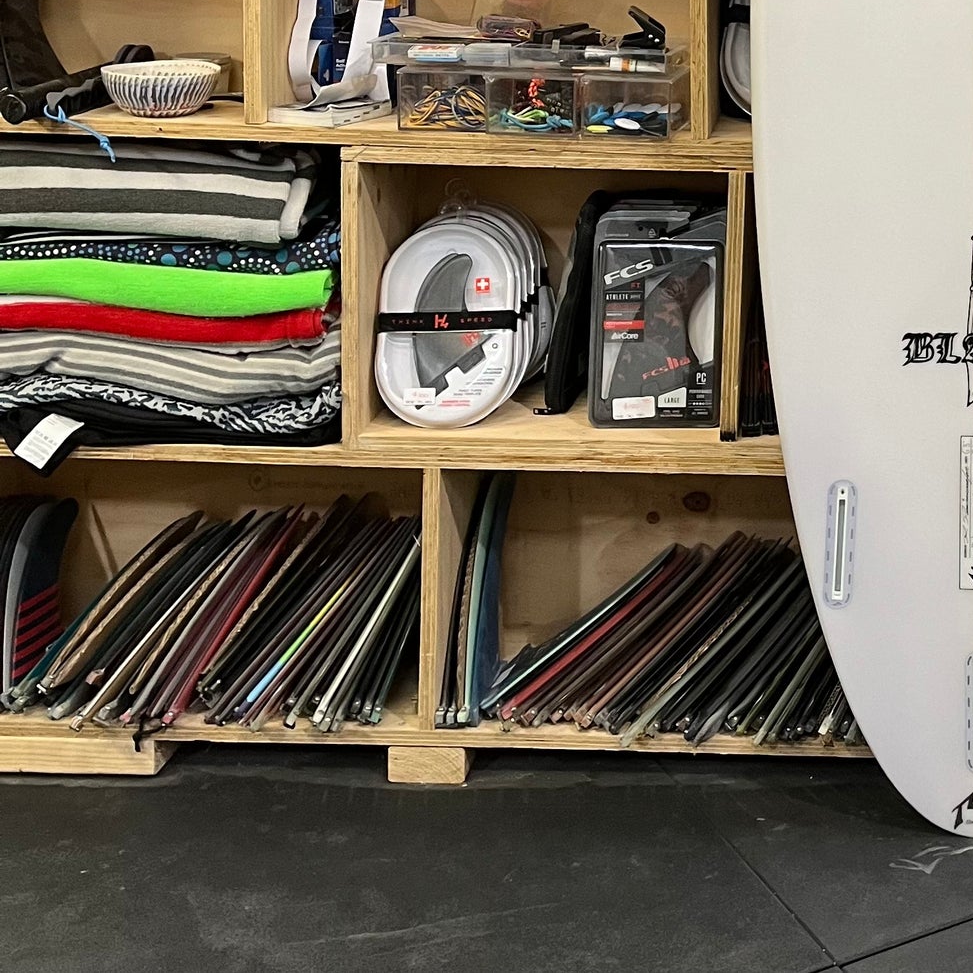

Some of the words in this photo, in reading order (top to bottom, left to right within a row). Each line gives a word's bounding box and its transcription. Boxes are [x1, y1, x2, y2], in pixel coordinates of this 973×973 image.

[603, 259, 654, 286] FCS
[606, 293, 629, 301] ATHLETE
[611, 332, 639, 340] AirCore
[642, 367, 669, 381] FCS
[696, 372, 707, 383] PC
